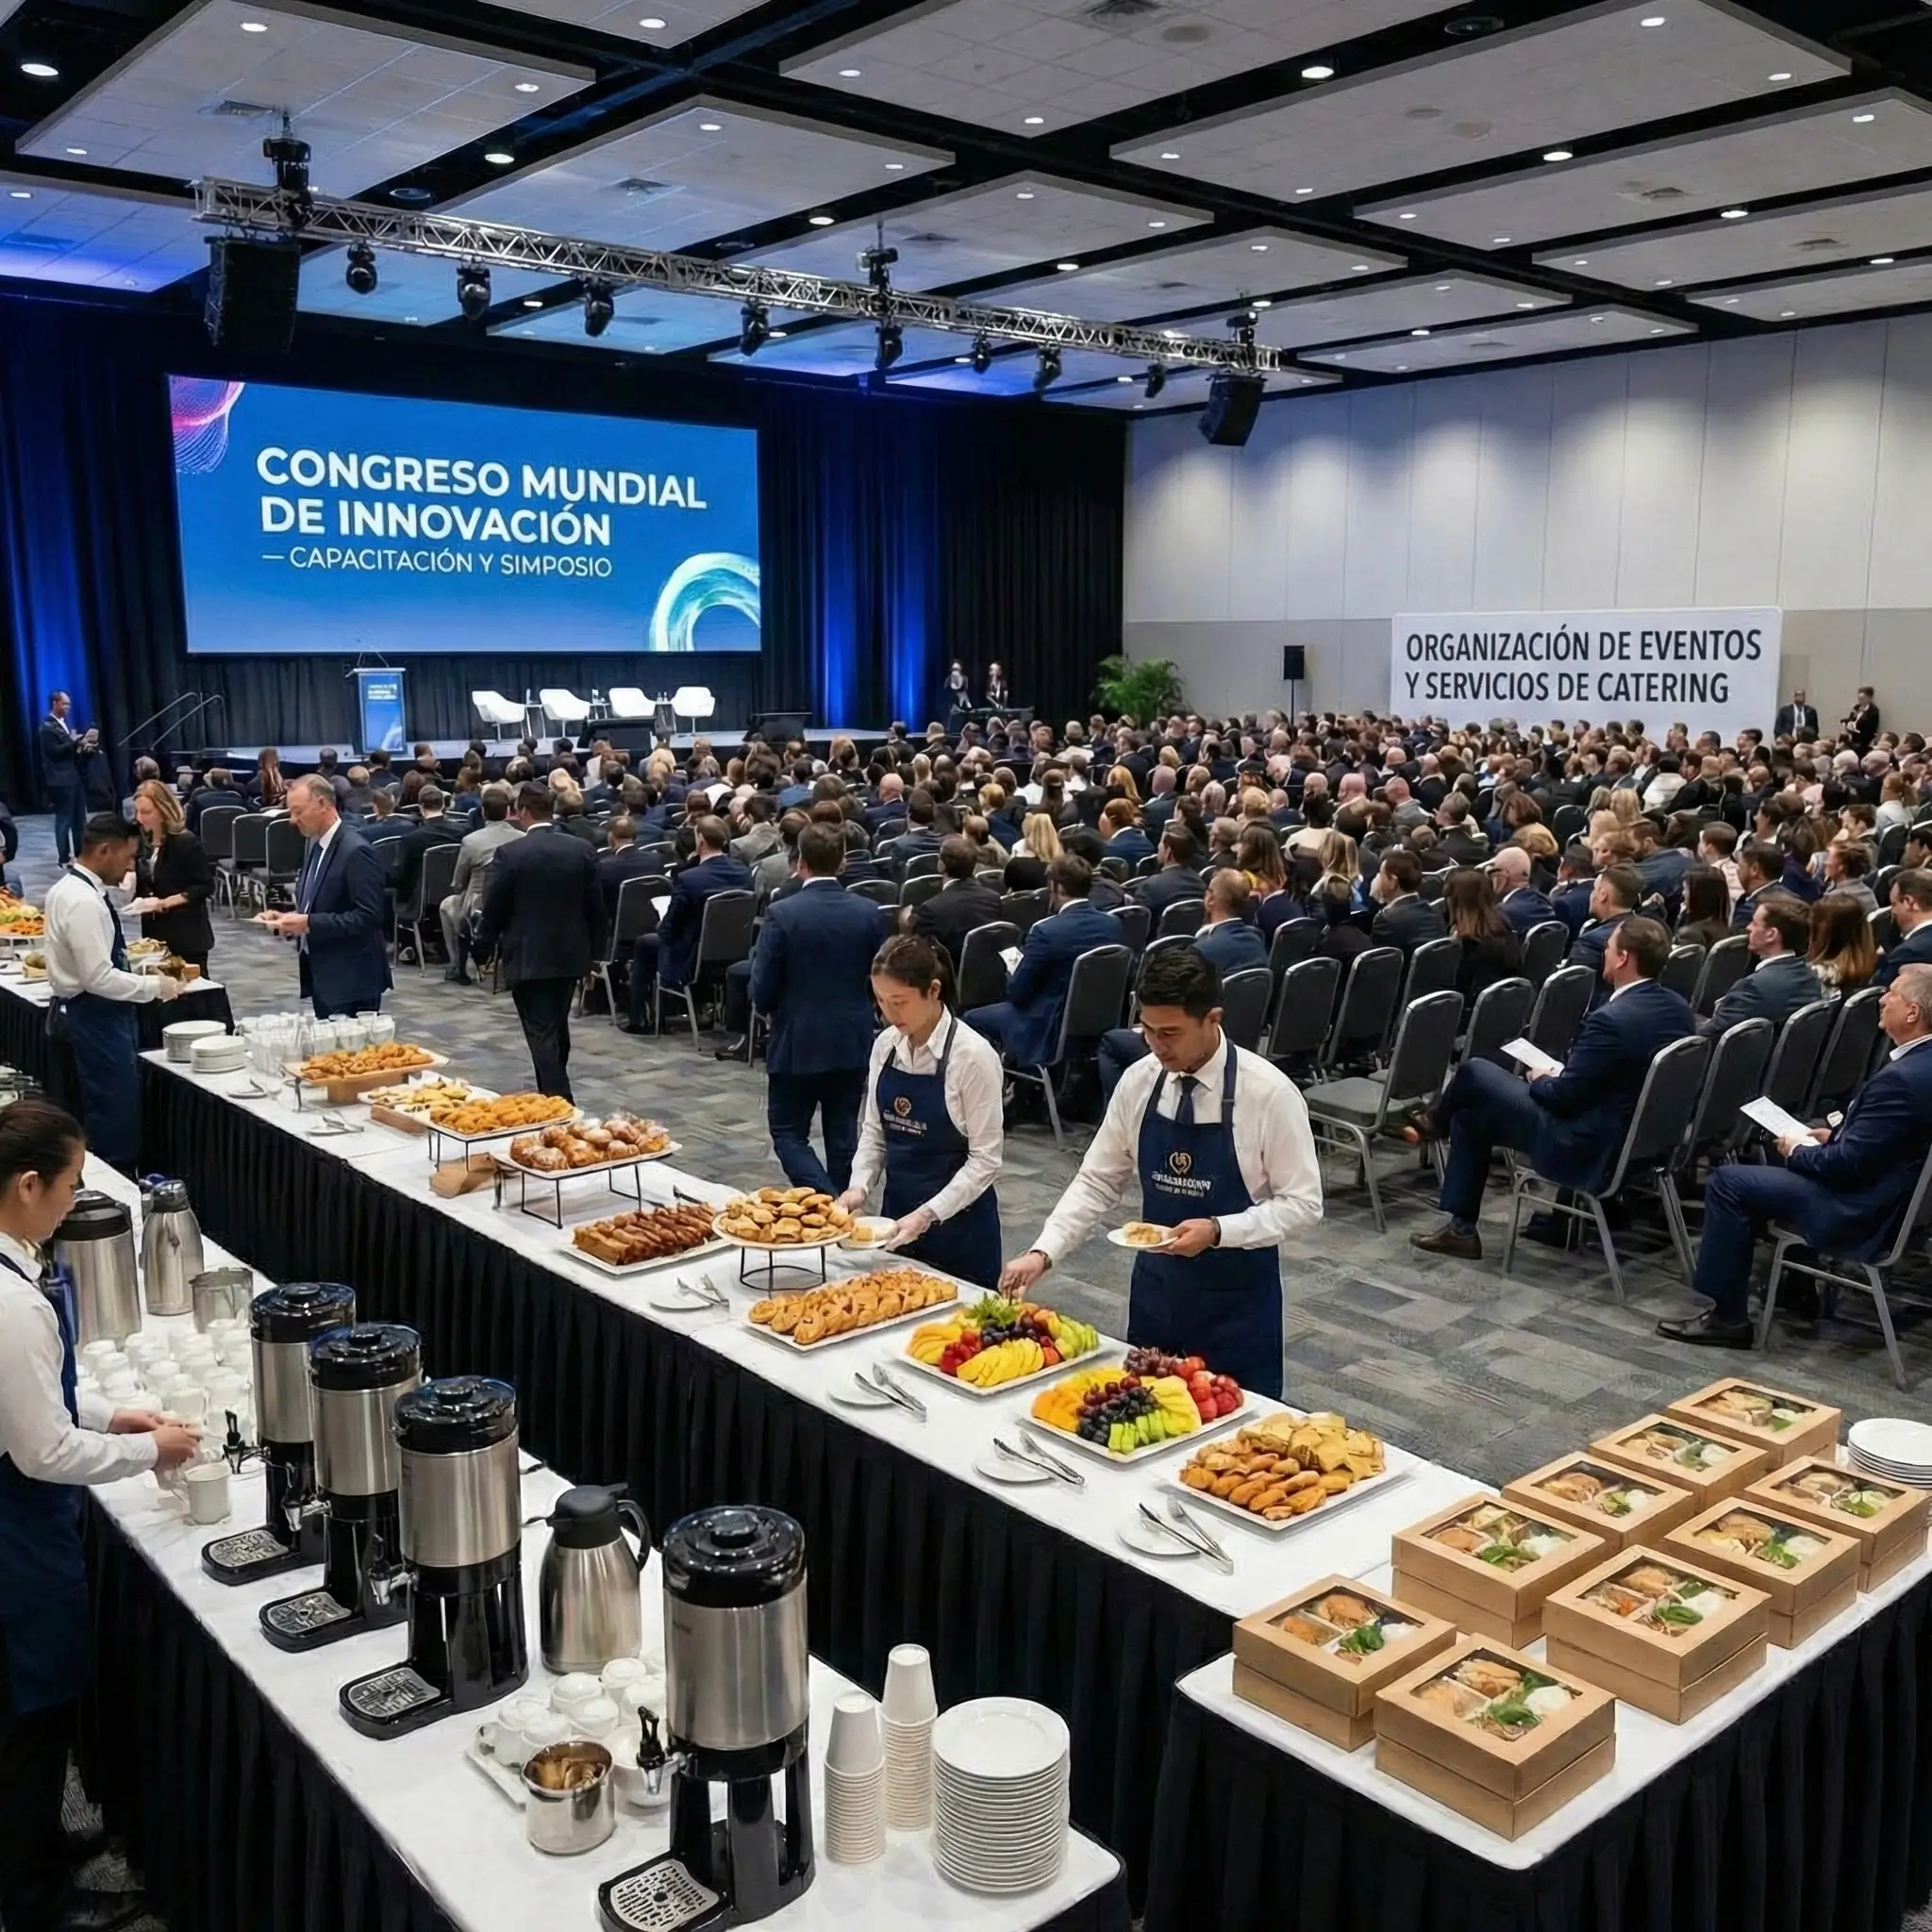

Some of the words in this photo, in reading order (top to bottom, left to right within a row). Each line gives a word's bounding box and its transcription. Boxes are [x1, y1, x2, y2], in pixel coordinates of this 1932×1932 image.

[257, 447, 510, 497] CONGRESO
[522, 464, 708, 508] MUNDIAL
[261, 495, 325, 534] DE
[339, 500, 610, 546] INNOVACIÓN
[290, 546, 473, 573] CAPACITACIÓN
[479, 554, 493, 573] Y
[501, 554, 612, 577] SIMPOSIO
[1406, 623, 1590, 662] ORGANIZACIÓN
[1599, 630, 1632, 661] DE
[1640, 628, 1762, 661] EVENTOS
[1405, 671, 1420, 699] Y
[1424, 671, 1550, 702] SERVICIOS
[1557, 672, 1590, 702] DE
[1597, 672, 1729, 704] CATERING
